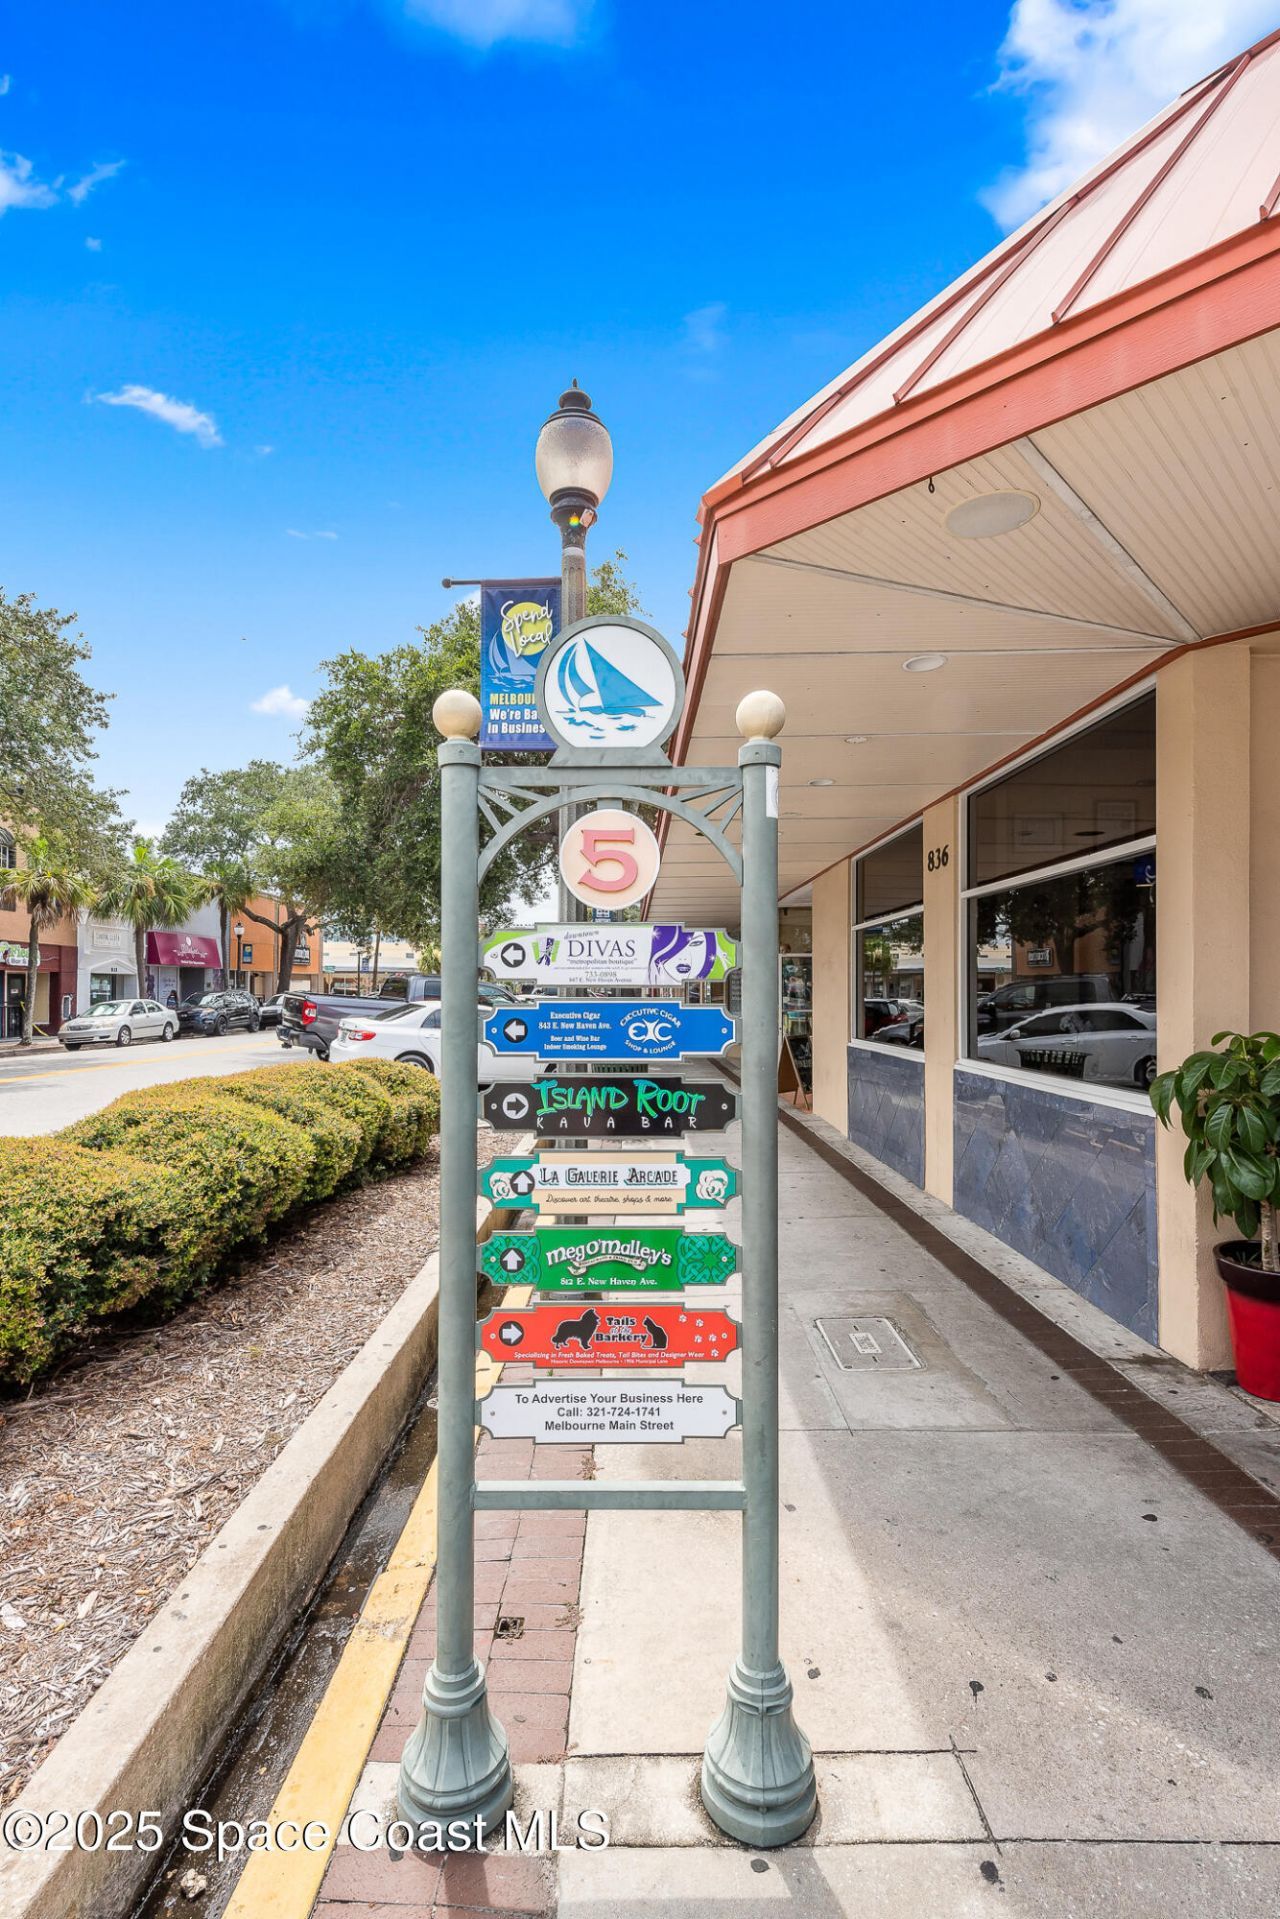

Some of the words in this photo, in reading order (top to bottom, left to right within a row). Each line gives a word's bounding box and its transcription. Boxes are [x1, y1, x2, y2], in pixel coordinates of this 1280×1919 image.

[500, 599, 553, 633] Spend
[509, 622, 553, 658] Local
[489, 708, 521, 721] We're
[578, 827, 638, 893] 5
[927, 844, 949, 872] 836
[563, 929, 599, 940] downtown
[568, 939, 636, 957] DIVAS
[550, 1011, 581, 1019] Executive
[582, 1011, 600, 1020] Cigar
[660, 1010, 681, 1028] CIGAR
[624, 1040, 642, 1052] SHOP
[649, 1041, 676, 1054] LOUNGE
[536, 1117, 616, 1129] KAVA
[641, 1117, 697, 1129] BAR
[546, 1194, 577, 1203] Discover
[622, 1194, 643, 1205] shops
[645, 1194, 652, 1203] &
[577, 1278, 585, 1286] E.
[588, 1278, 606, 1286] New
[610, 1278, 636, 1286] Haven
[640, 1278, 657, 1286] Ave.
[606, 1316, 636, 1326] Tails
[595, 1332, 647, 1343] Barkery
[514, 1351, 549, 1360] Specializing
[596, 1351, 616, 1359] Treats,
[660, 1351, 687, 1360] Designer
[515, 1394, 529, 1404] To
[532, 1394, 586, 1404] Advertise
[590, 1394, 618, 1403] Your
[620, 1394, 673, 1403] Business
[676, 1394, 704, 1403] Here
[557, 1407, 583, 1417] Call:
[586, 1407, 661, 1417] 321-724-1741
[545, 1421, 606, 1431] Melbourne
[609, 1421, 636, 1430] Main
[640, 1420, 674, 1430] Street
